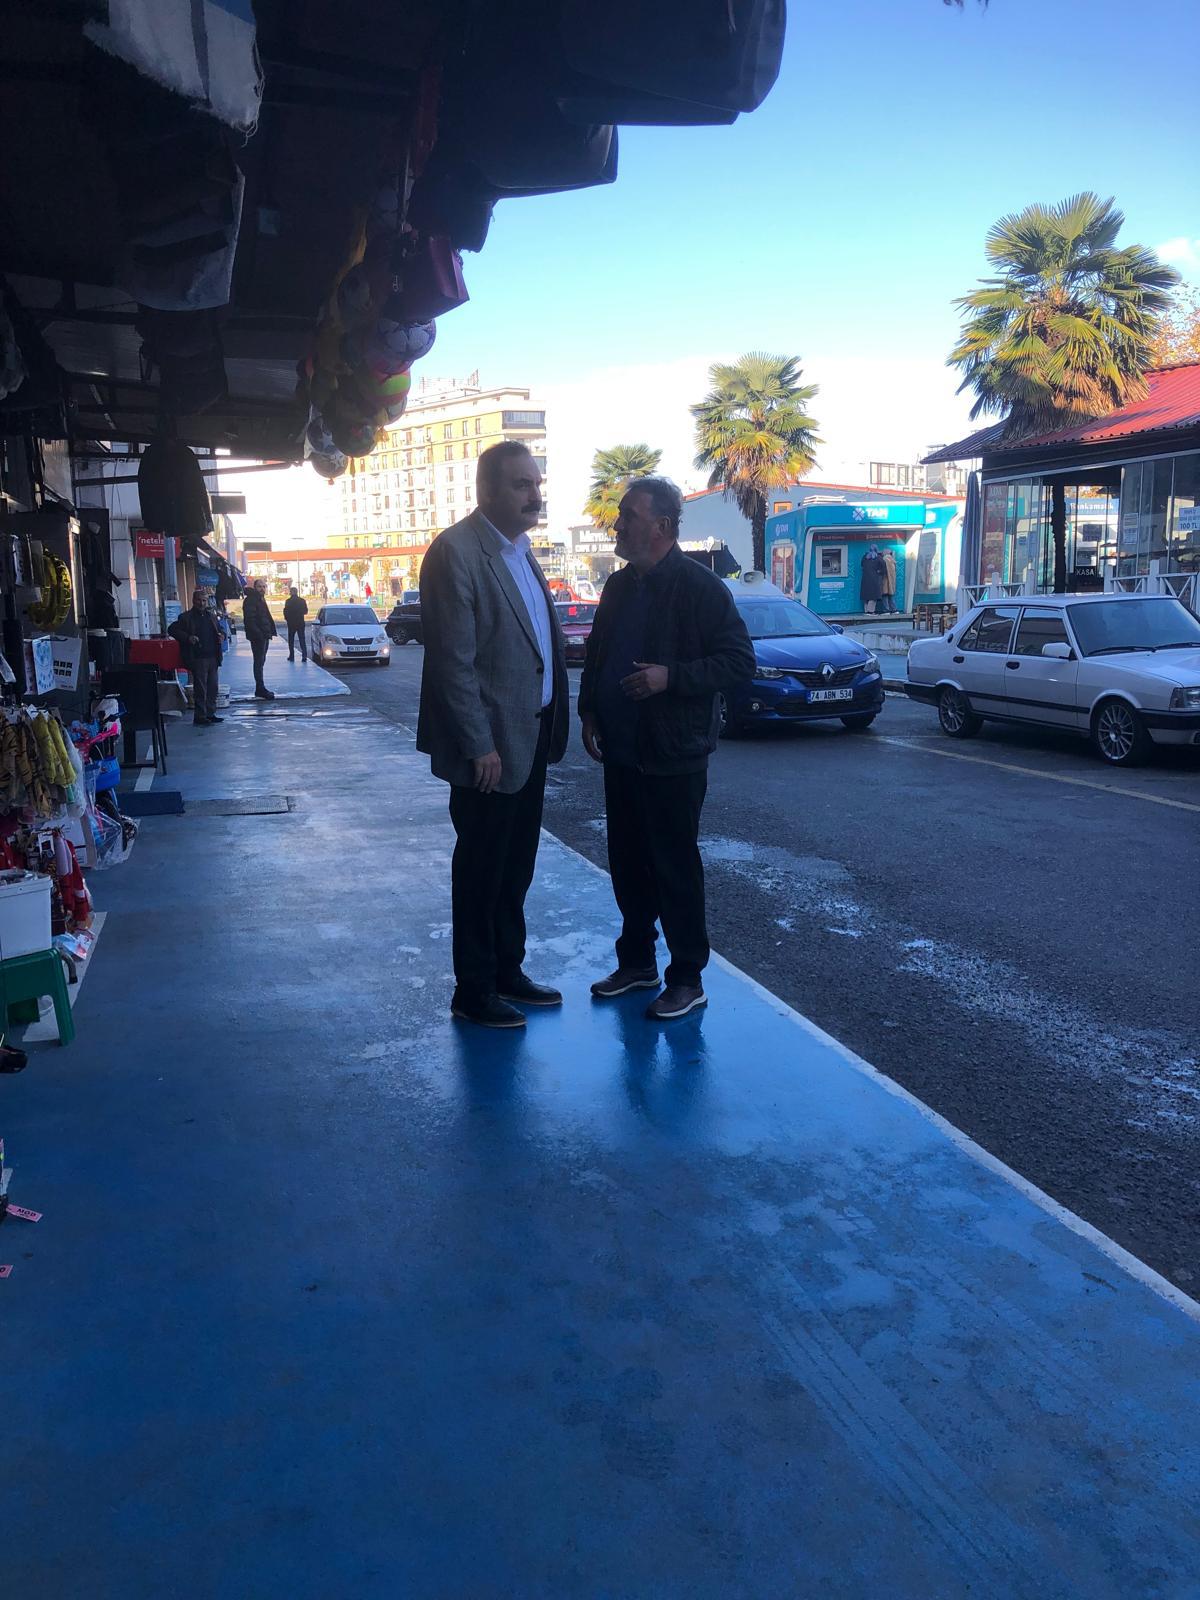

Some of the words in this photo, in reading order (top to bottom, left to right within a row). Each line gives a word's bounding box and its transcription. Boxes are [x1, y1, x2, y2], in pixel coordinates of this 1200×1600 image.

[1180, 522, 1191, 530] 100
[811, 690, 820, 701] 74
[839, 689, 852, 699] 534
